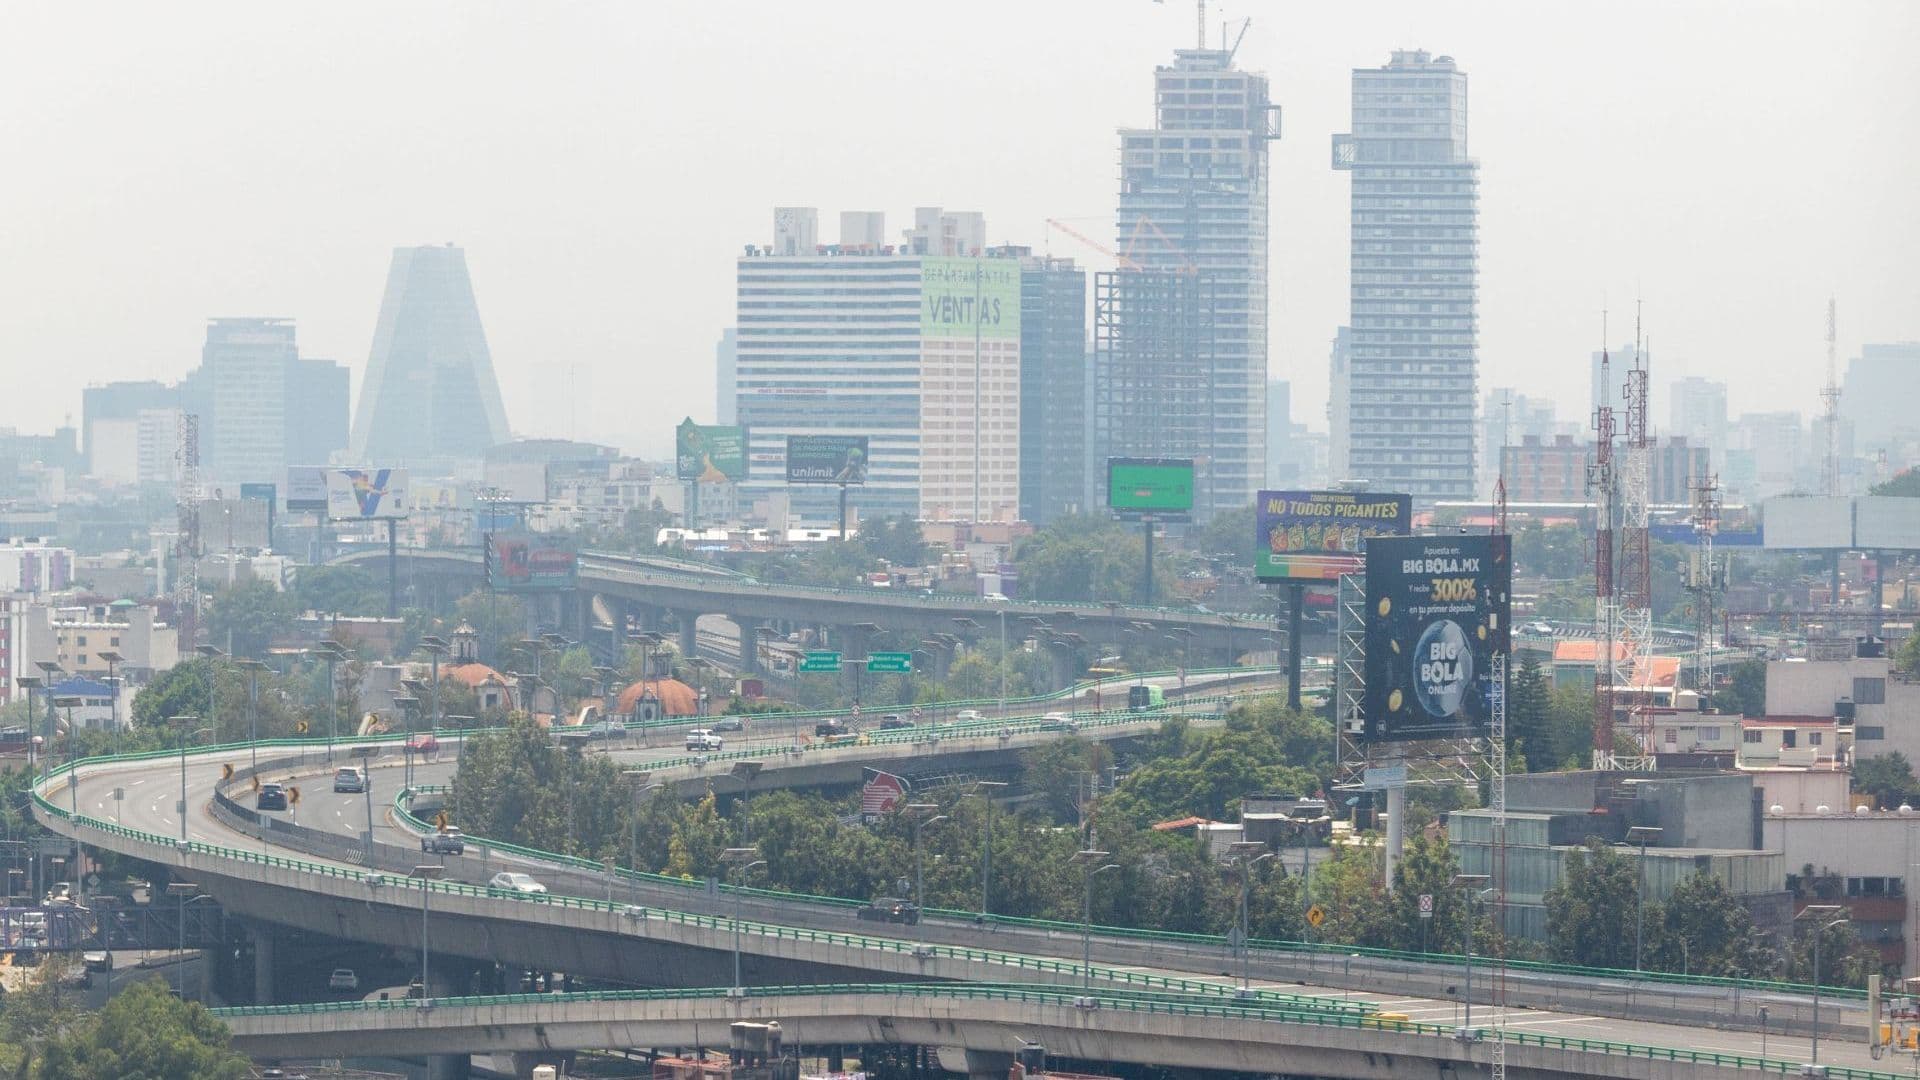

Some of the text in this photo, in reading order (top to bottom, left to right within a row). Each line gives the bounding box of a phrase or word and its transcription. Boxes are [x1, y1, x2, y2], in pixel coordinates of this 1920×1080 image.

[929, 295, 1001, 324] VENTAS
[791, 465, 833, 477] unlimit
[1267, 499, 1398, 518] NO TODOS PICANTES
[1424, 546, 1449, 556] Apuesta
[1402, 557, 1480, 574] BIG BOLA.MX
[1413, 584, 1430, 592] recibe
[1431, 577, 1477, 601] 300%
[1409, 606, 1418, 614] en
[1418, 606, 1426, 615] tu
[1426, 605, 1448, 615] primer
[1430, 642, 1457, 660] BIG
[1421, 660, 1464, 683] BOLA
